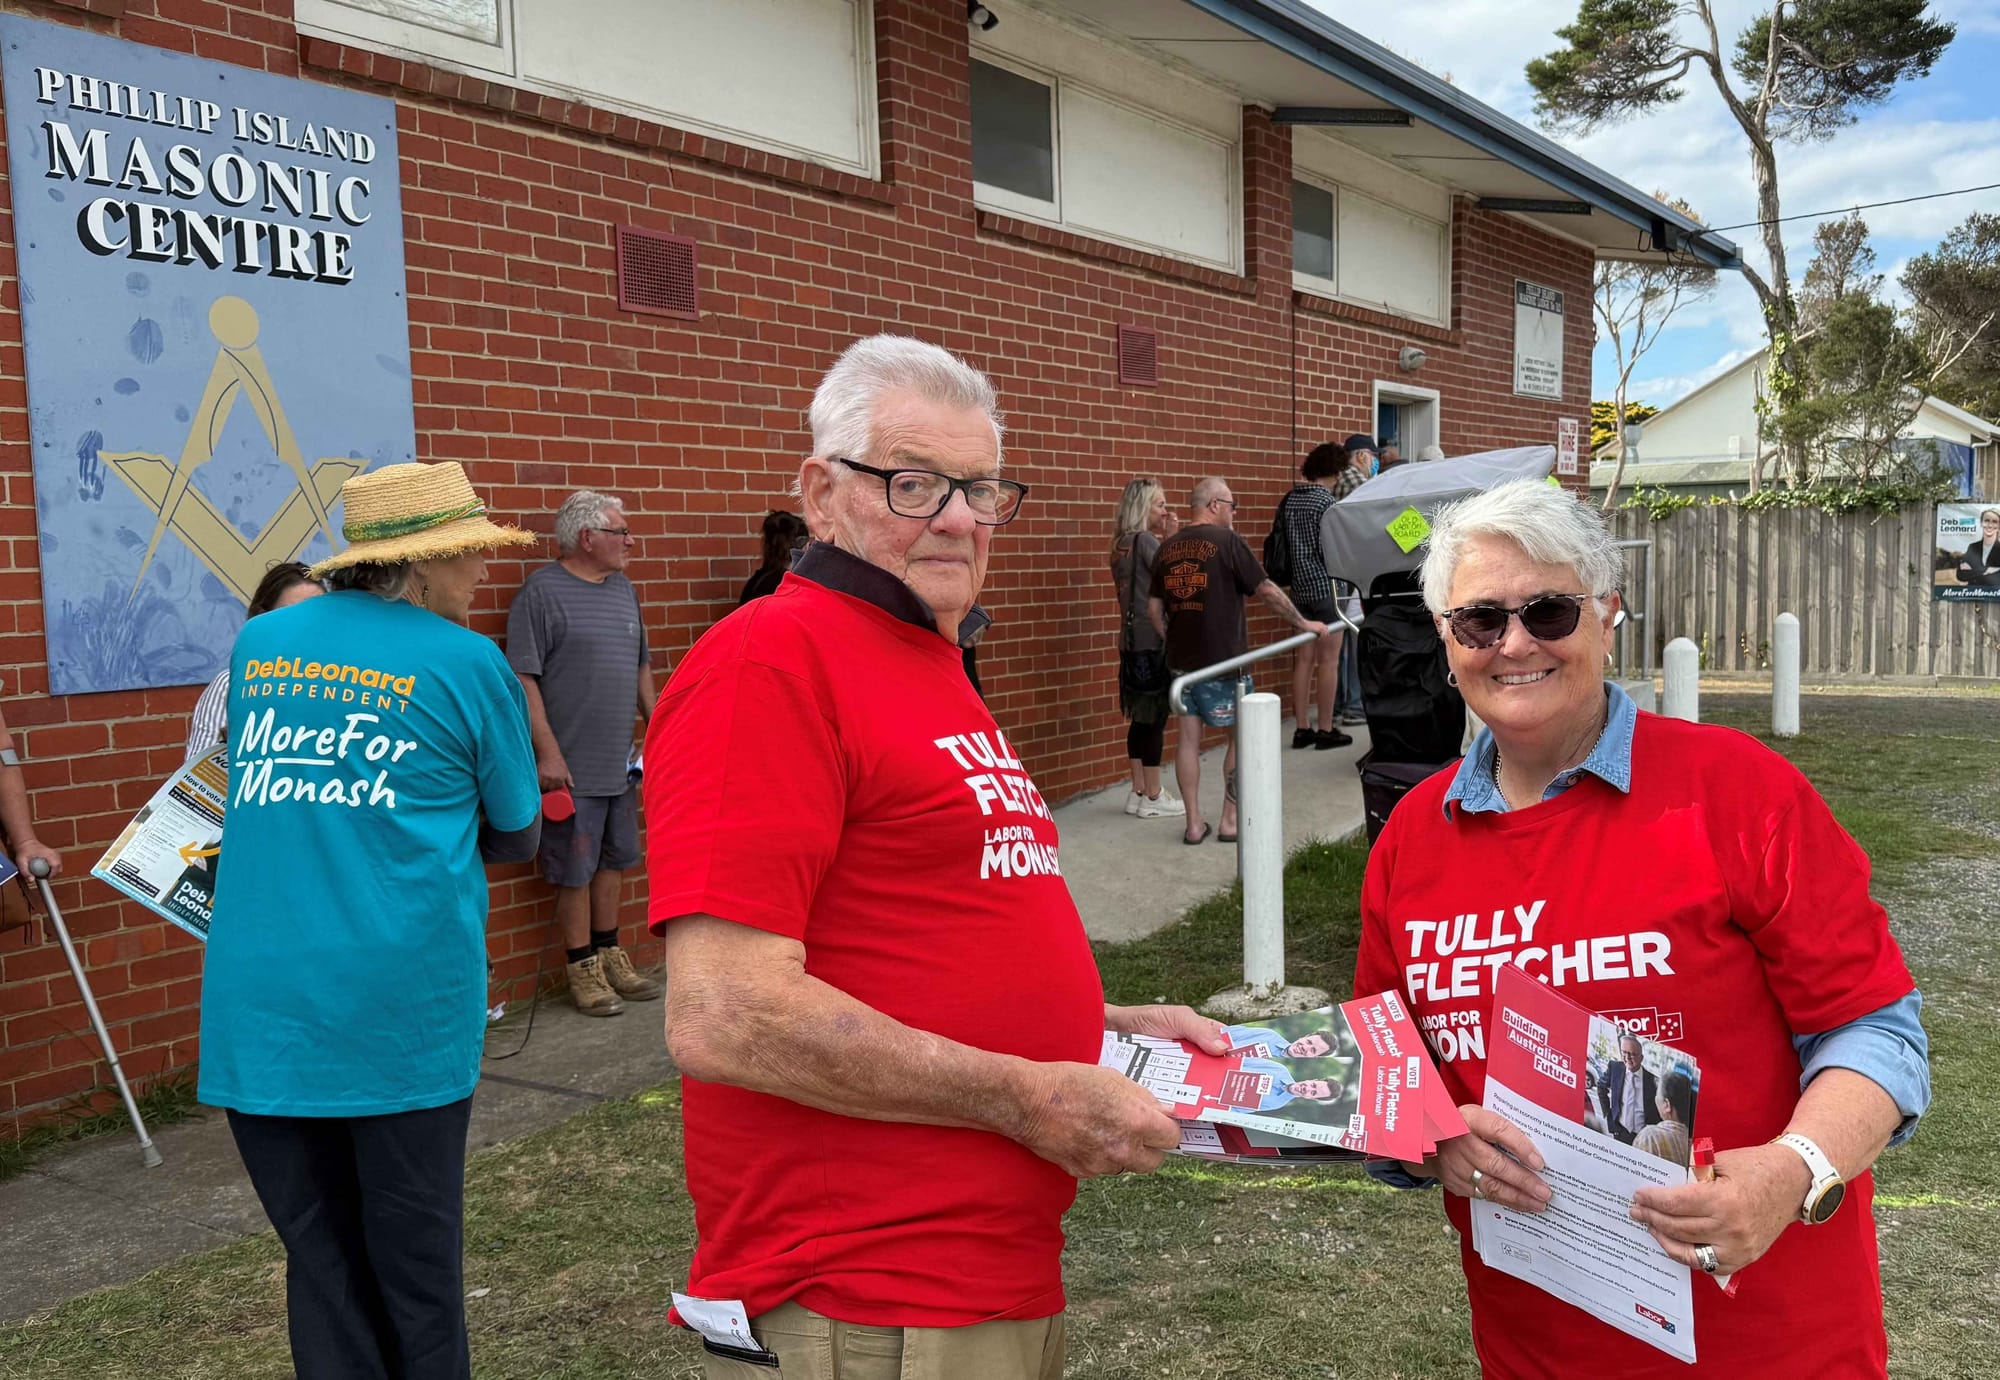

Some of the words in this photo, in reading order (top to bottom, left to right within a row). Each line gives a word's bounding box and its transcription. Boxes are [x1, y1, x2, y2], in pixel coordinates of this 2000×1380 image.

[34, 67, 222, 134] PHILLIP
[232, 106, 376, 165] ISLAND
[41, 120, 373, 227] MASONIC
[77, 197, 355, 286] CENTRE
[1940, 525, 1976, 533] Leonard
[245, 656, 416, 697] DebLeonard
[241, 683, 410, 714] INDEPENDENT
[236, 707, 418, 763] MoreFor
[933, 729, 1025, 772] TULL
[183, 773, 198, 789] How
[198, 784, 206, 794] to
[206, 791, 221, 804] vote
[234, 757, 397, 809] Monash
[984, 826, 1022, 844] LABOR
[1022, 825, 1035, 841] FOR
[173, 892, 213, 922] Leona
[180, 881, 207, 903] Deb
[1405, 899, 1547, 958] TULLY
[1405, 931, 1676, 1005] FLETCHER
[1370, 1003, 1387, 1028] Tully
[1388, 1000, 1401, 1019] VOTE
[1449, 1010, 1481, 1026] FOR
[1359, 1007, 1371, 1024] Labor
[1367, 1022, 1375, 1033] for
[1371, 1030, 1385, 1057] Monash
[1503, 1010, 1546, 1044] Building
[1509, 1029, 1569, 1069] Australia's
[1376, 1065, 1386, 1084] Labor
[1386, 1065, 1401, 1090] Tully
[1409, 1066, 1417, 1086] VOTE
[1535, 1058, 1574, 1085] Future
[1376, 1083, 1385, 1092] for
[1375, 1091, 1385, 1116] Monash
[1385, 1089, 1401, 1132] Fletcher
[1541, 1120, 1557, 1131] takes
[1556, 1127, 1573, 1138] time,
[1571, 1134, 1582, 1142] but
[1582, 1138, 1609, 1153] Australia
[1613, 1151, 1637, 1165] turning
[1647, 1166, 1670, 1178] corner.
[1575, 1145, 1591, 1156] Labor
[1592, 1152, 1629, 1172] Government
[1630, 1168, 1640, 1176] will
[1640, 1172, 1657, 1182] build
[1636, 1305, 1663, 1322] Labor
